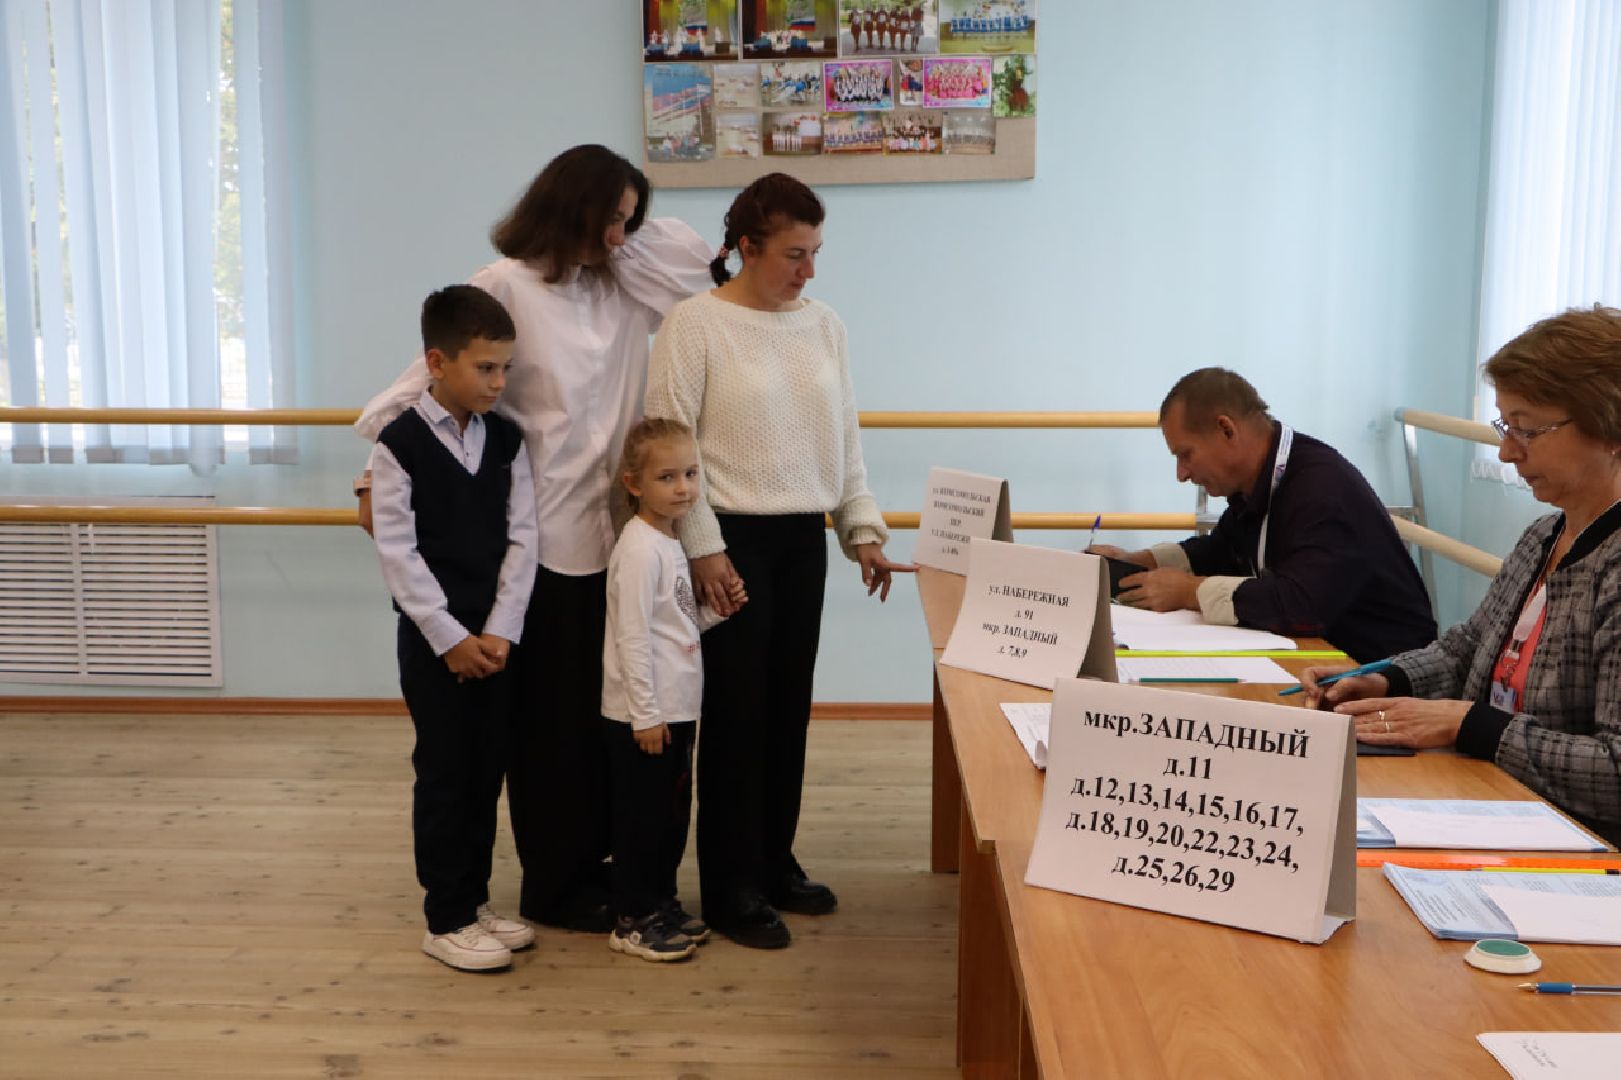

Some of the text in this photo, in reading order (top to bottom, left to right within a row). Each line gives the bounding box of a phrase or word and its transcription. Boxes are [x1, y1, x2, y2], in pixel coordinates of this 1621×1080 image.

[1083, 709, 1310, 759] мкр.ЗАПАДНЫЙ
[1162, 755, 1212, 780] д.11
[1070, 776, 1304, 836] д.12,13,14,15,16,17,
[1065, 810, 1299, 874] д.18,19,20,22,23,24,
[1111, 854, 1235, 893] д.25,26,29
